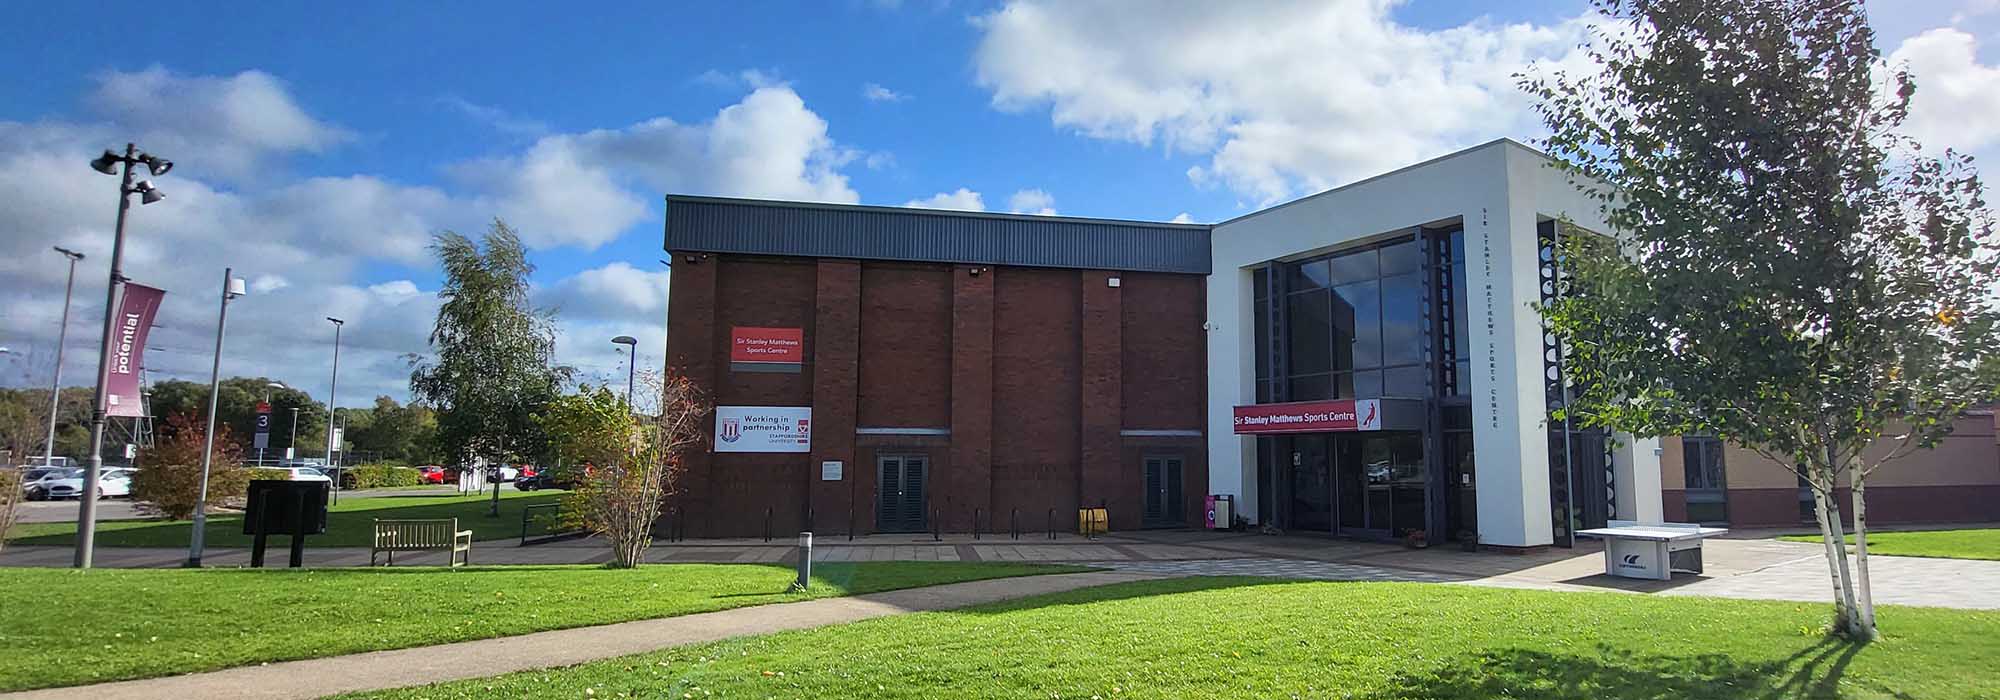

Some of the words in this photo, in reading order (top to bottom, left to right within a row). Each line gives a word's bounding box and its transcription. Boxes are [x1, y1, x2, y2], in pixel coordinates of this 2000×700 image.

[118, 313, 140, 374] potential
[736, 337, 745, 345] Sir
[746, 338, 769, 346] Stanley
[746, 346, 766, 354] Sports
[258, 415, 268, 427] 3
[744, 415, 779, 424] Working
[780, 415, 789, 423] in
[1235, 415, 1243, 425] Sir
[1244, 414, 1269, 426] Stanley
[1269, 413, 1303, 424] Matthews
[1304, 412, 1328, 422] Sports
[1329, 411, 1355, 421] Centre
[743, 423, 790, 432] partnership
